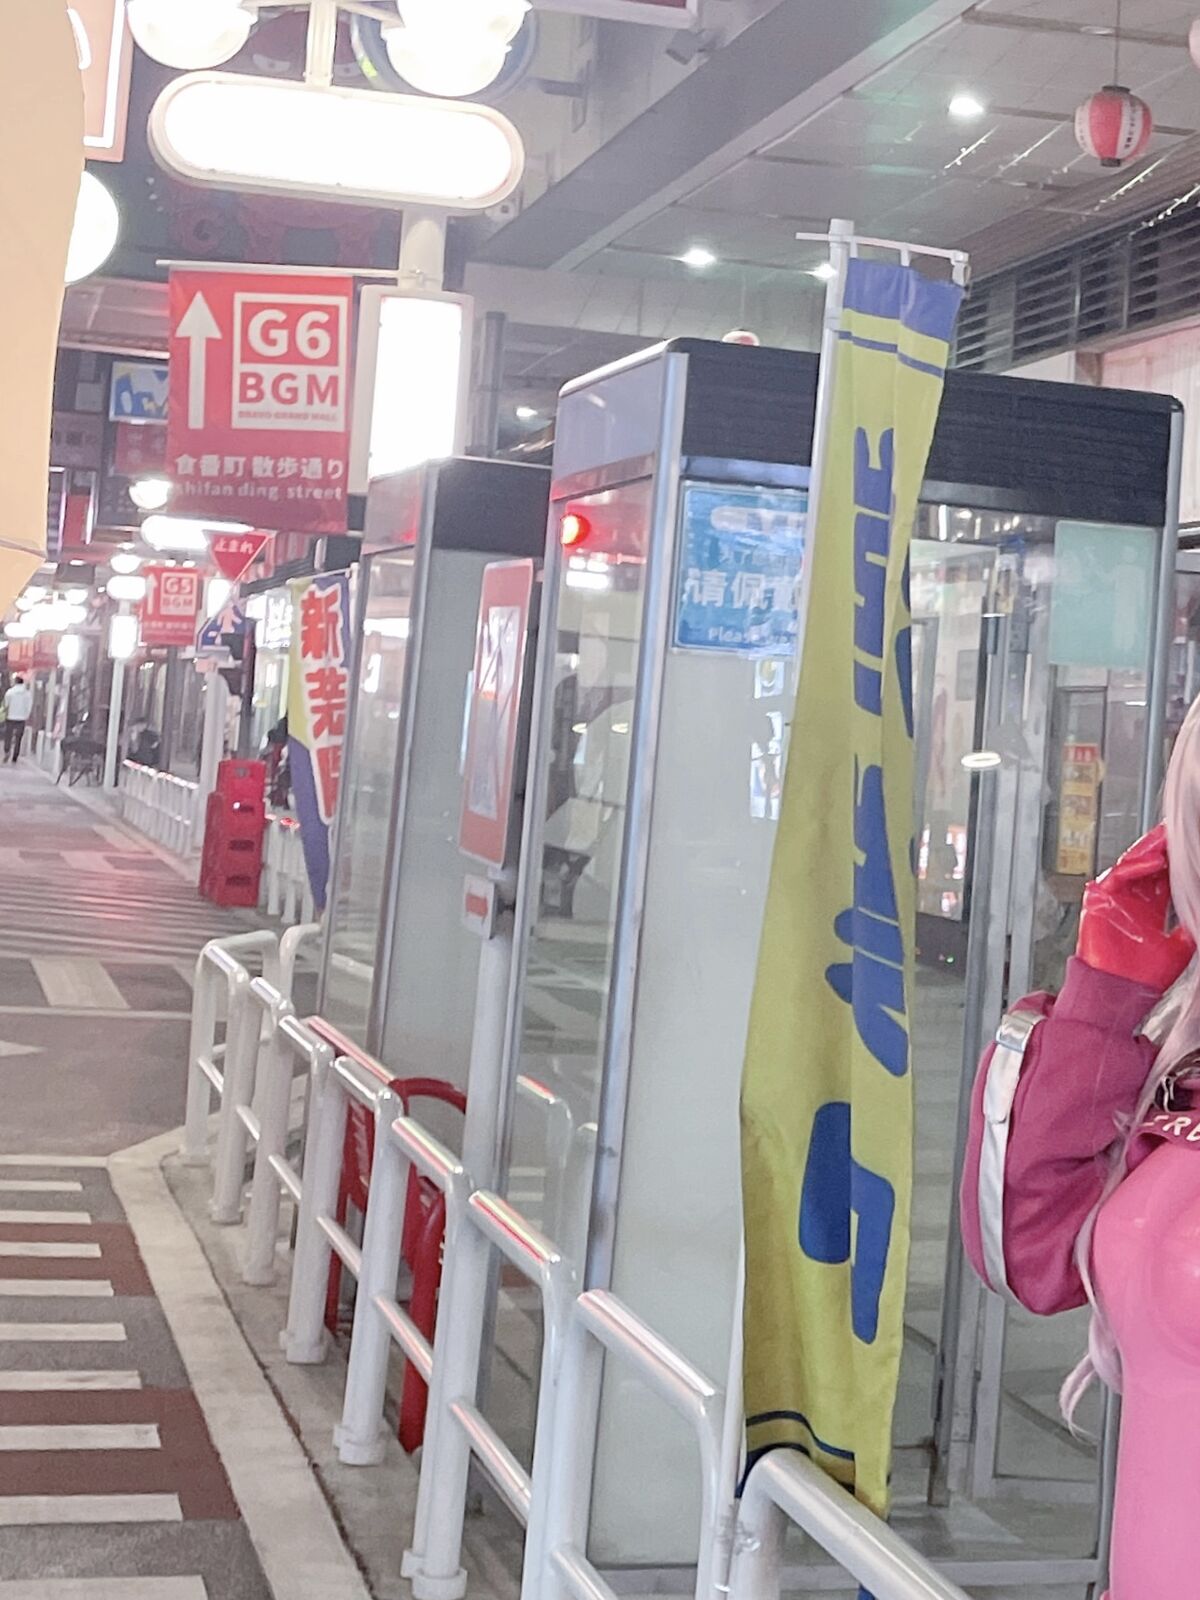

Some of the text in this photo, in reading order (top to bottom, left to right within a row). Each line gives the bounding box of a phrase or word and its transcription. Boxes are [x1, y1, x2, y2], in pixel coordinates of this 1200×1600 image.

[247, 308, 331, 360] G6
[238, 371, 339, 407] BGM
[238, 483, 279, 500] ding
[286, 484, 342, 500] street
[214, 538, 254, 554] 止まれ
[166, 577, 192, 594] G5
